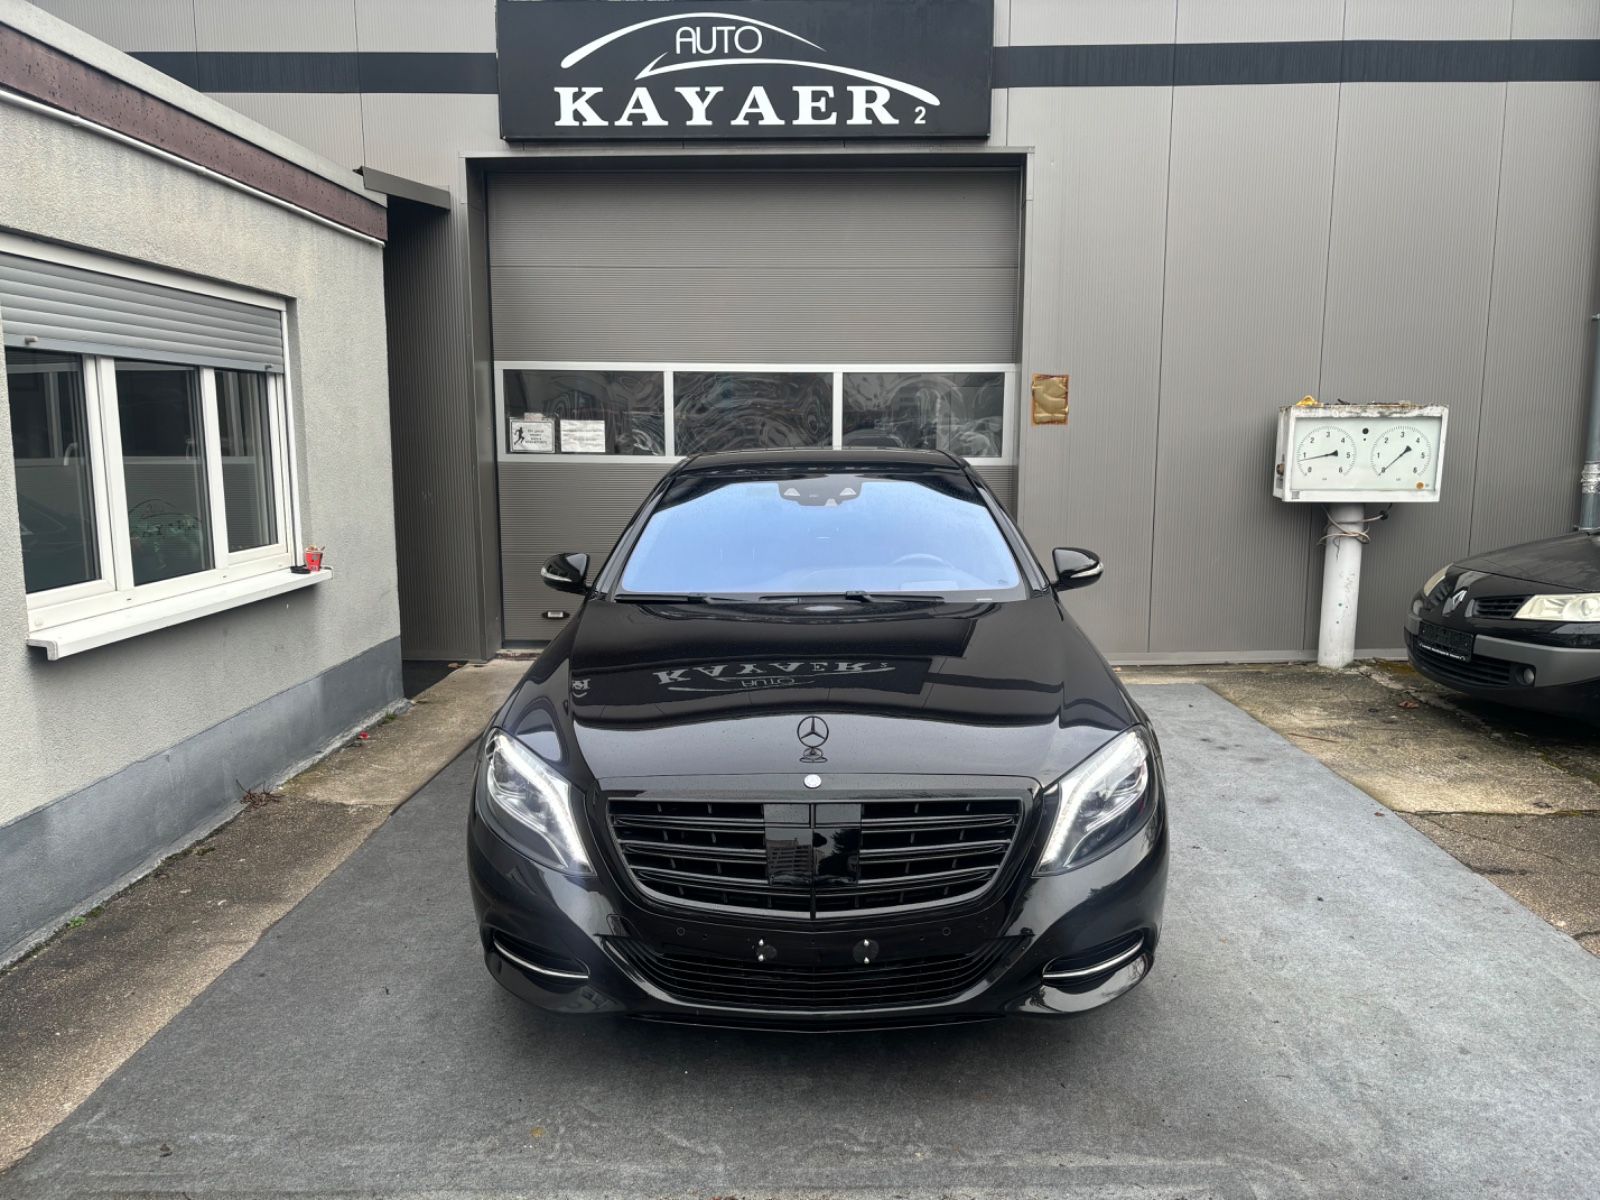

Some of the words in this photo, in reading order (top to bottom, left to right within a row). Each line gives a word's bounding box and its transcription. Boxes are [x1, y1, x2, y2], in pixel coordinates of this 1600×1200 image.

[675, 25, 763, 54] AUTO
[553, 85, 900, 126] KAYAER
[914, 105, 926, 124] 2
